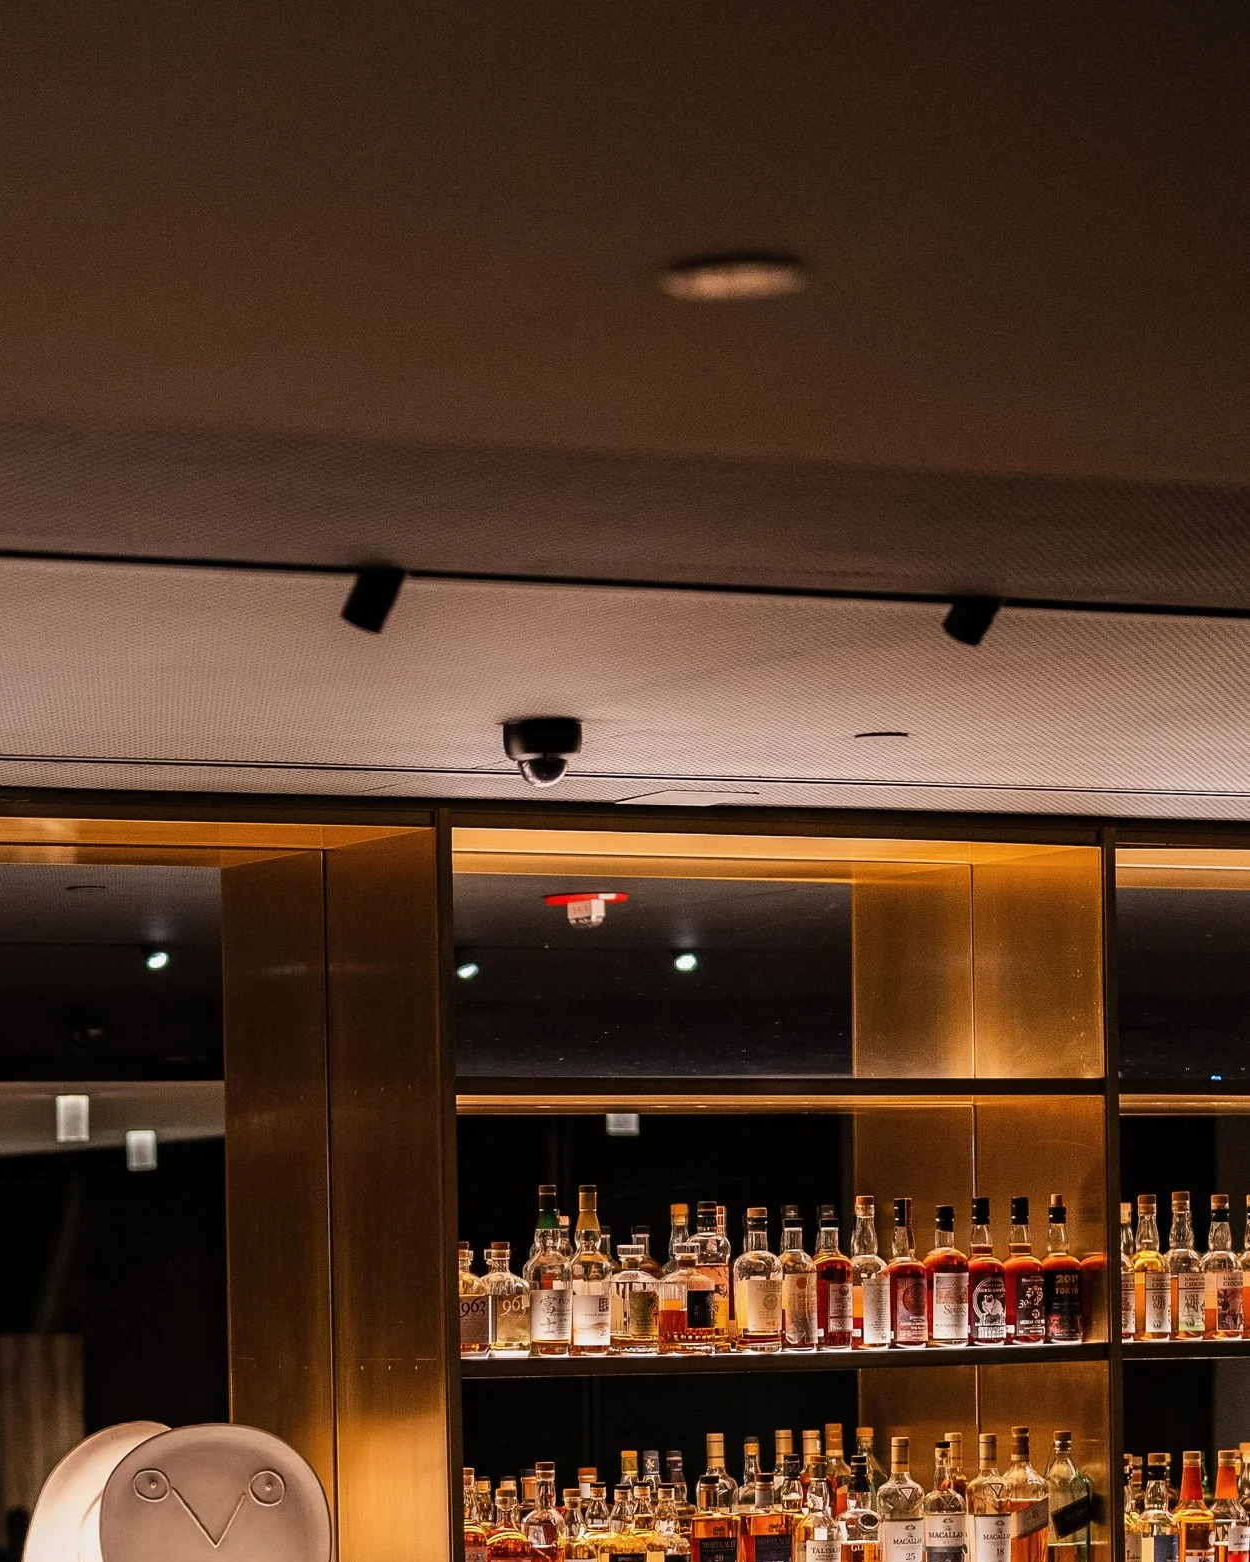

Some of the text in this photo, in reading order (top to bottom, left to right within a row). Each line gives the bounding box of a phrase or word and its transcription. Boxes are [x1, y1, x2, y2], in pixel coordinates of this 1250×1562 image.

[460, 1297, 486, 1318] 963
[996, 1548, 1005, 1556] 18
[714, 1554, 724, 1562] 20
[905, 1552, 916, 1561] 25
